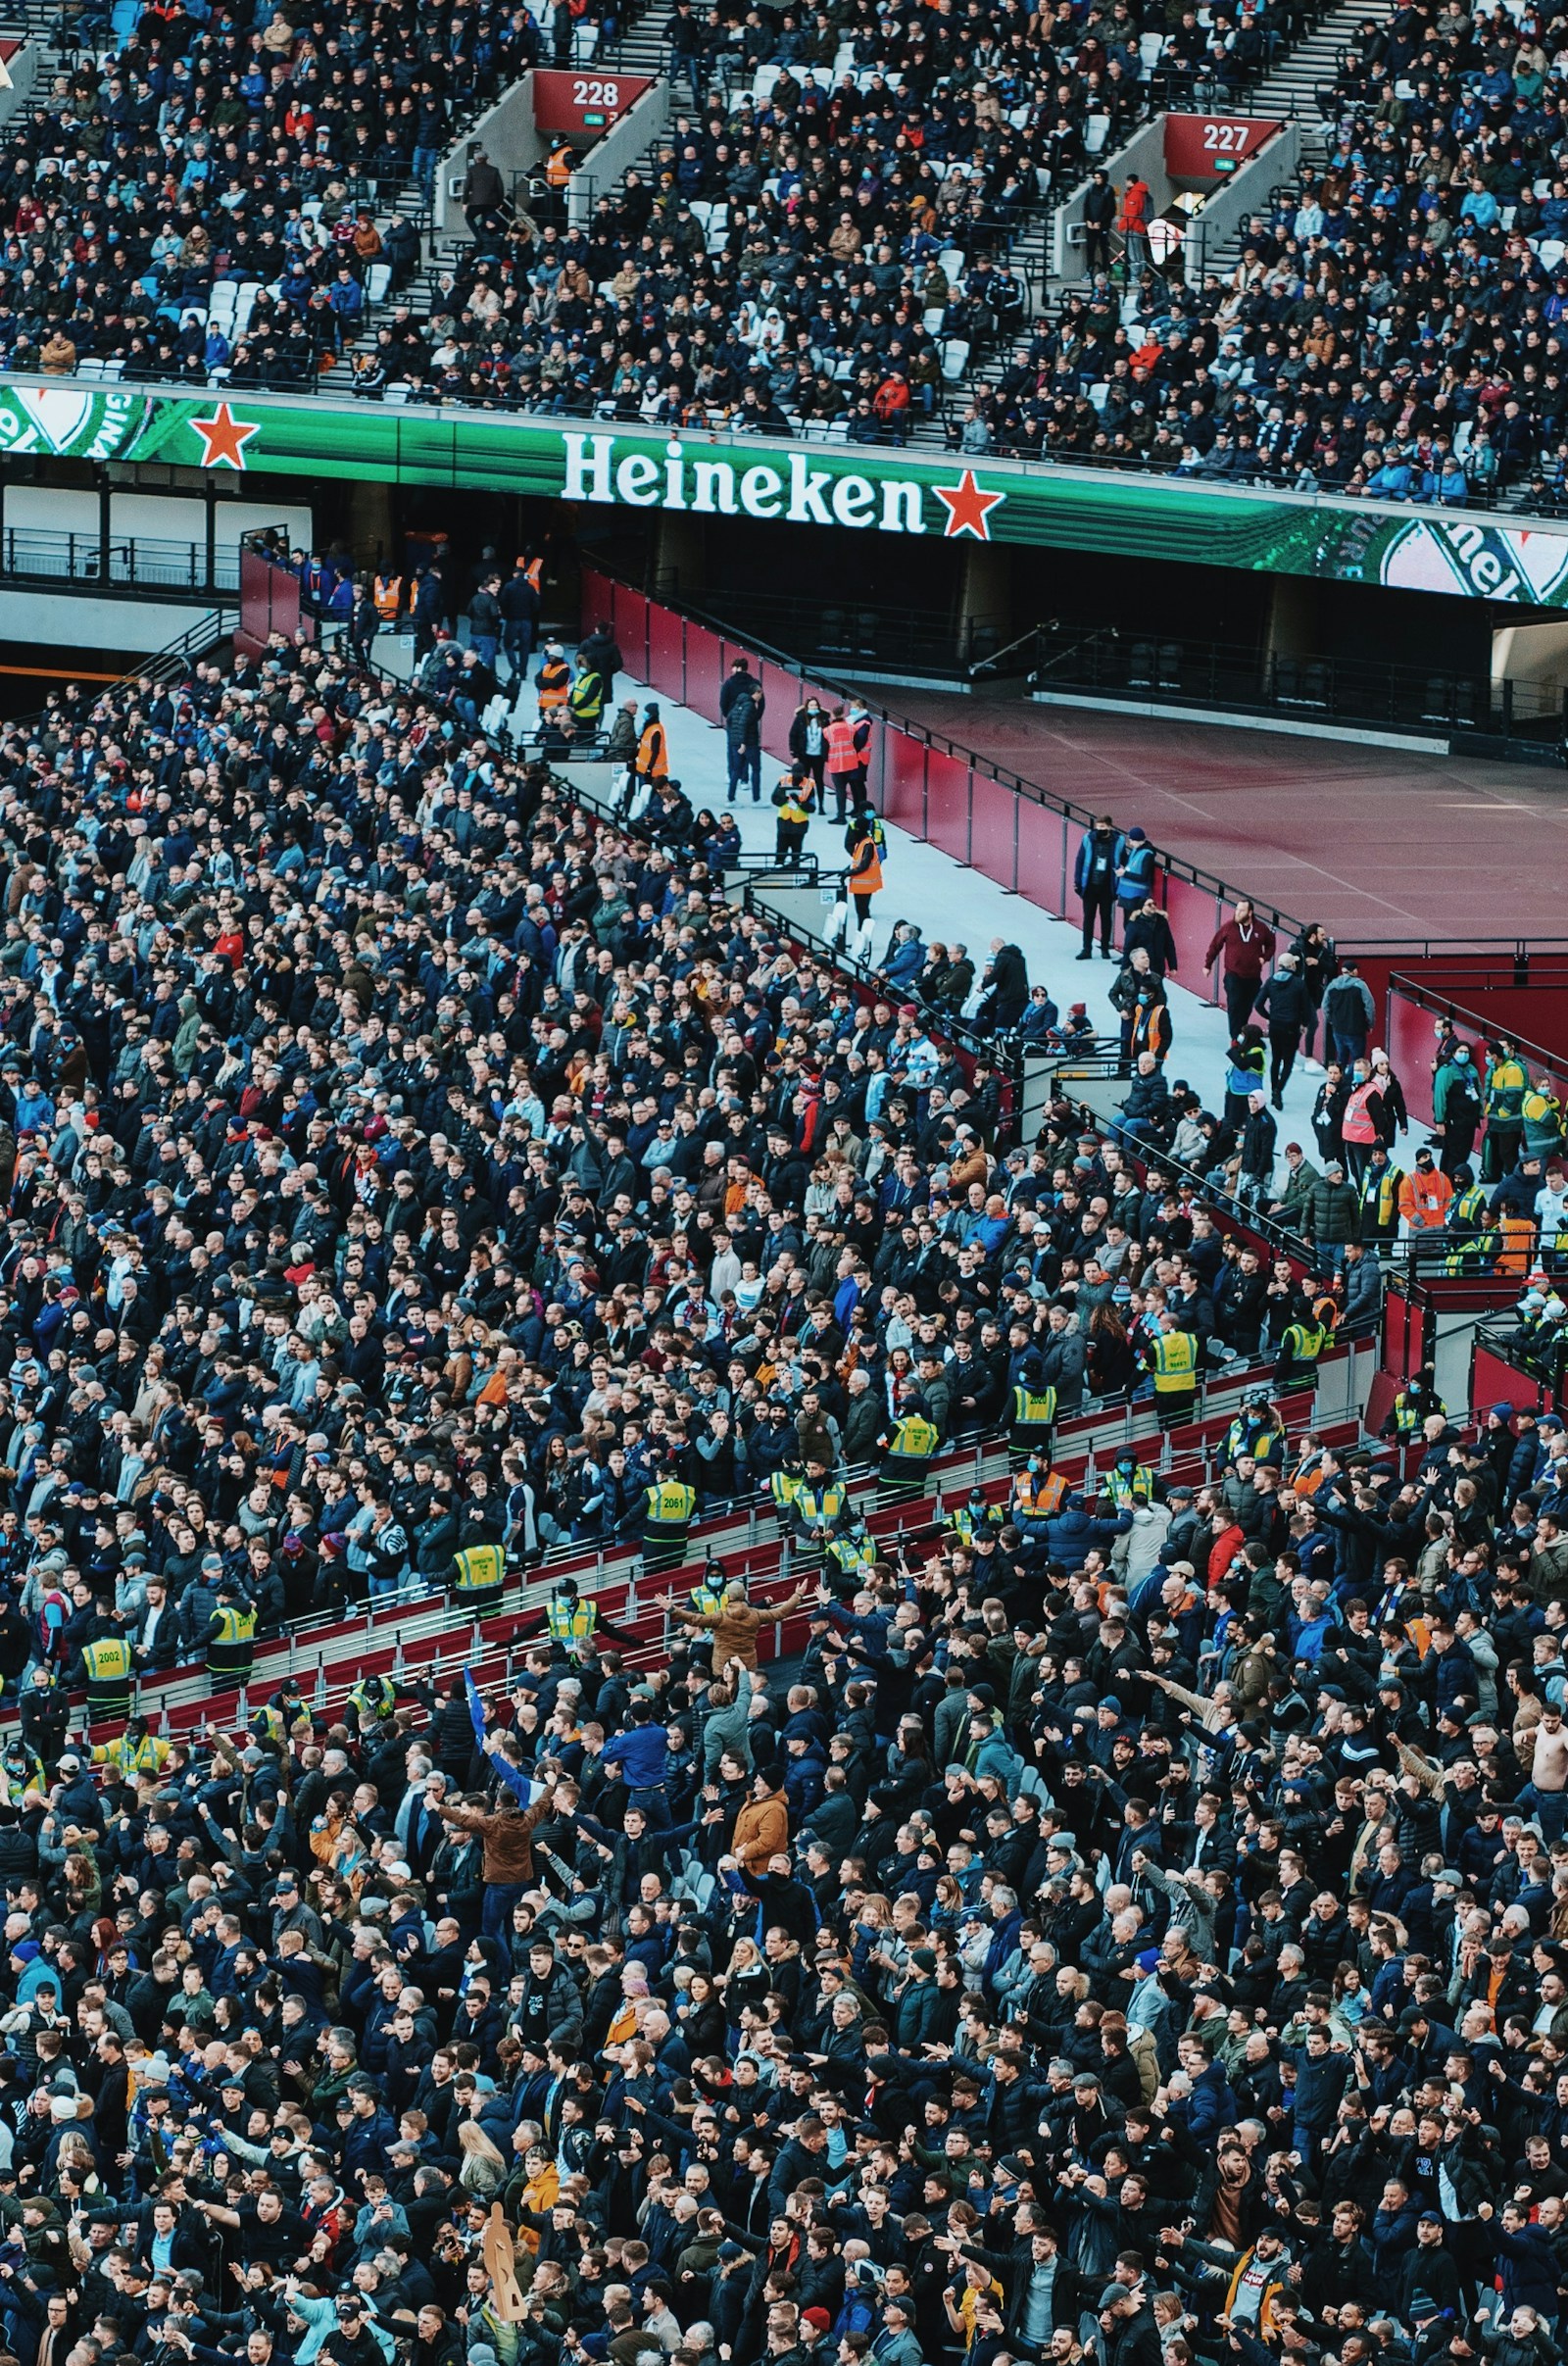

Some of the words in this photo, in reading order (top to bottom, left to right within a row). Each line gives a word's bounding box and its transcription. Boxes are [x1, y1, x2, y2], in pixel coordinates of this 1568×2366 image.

[572, 80, 618, 107] 228
[1203, 124, 1250, 151] 227
[560, 432, 927, 534] Heineken
[663, 1498, 683, 1508] 2061
[99, 1651, 120, 1663] 2002
